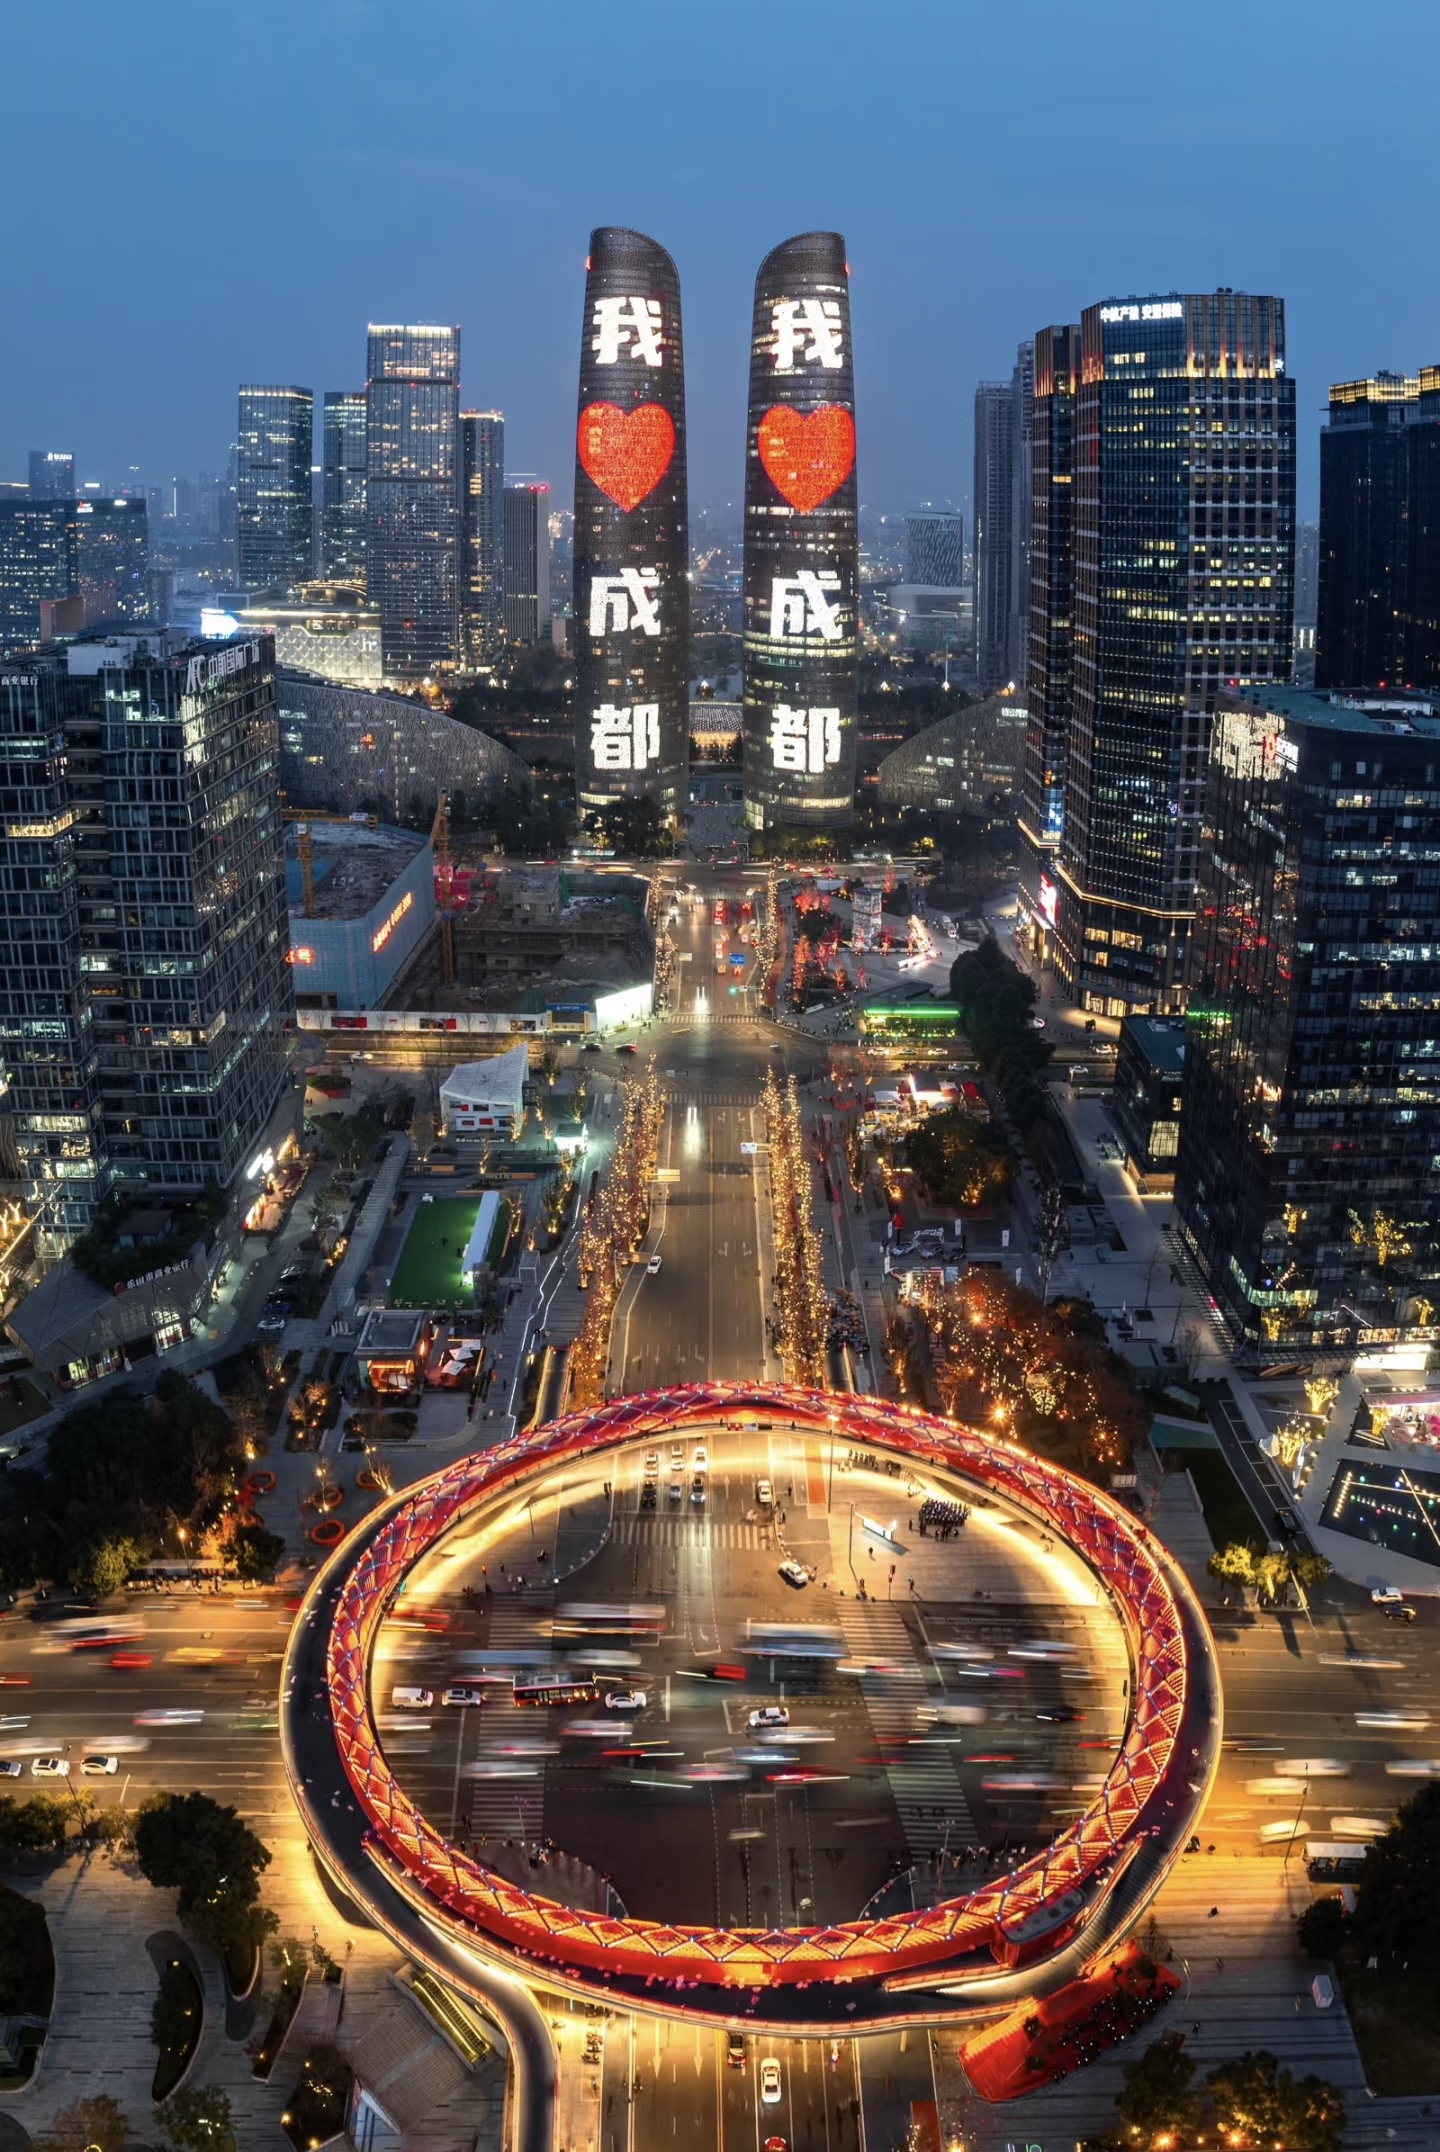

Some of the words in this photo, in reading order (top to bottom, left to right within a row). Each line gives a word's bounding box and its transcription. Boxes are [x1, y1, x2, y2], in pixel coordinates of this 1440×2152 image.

[591, 297, 662, 367] 我
[769, 300, 844, 369] 我
[1, 675, 39, 687] 商业银行
